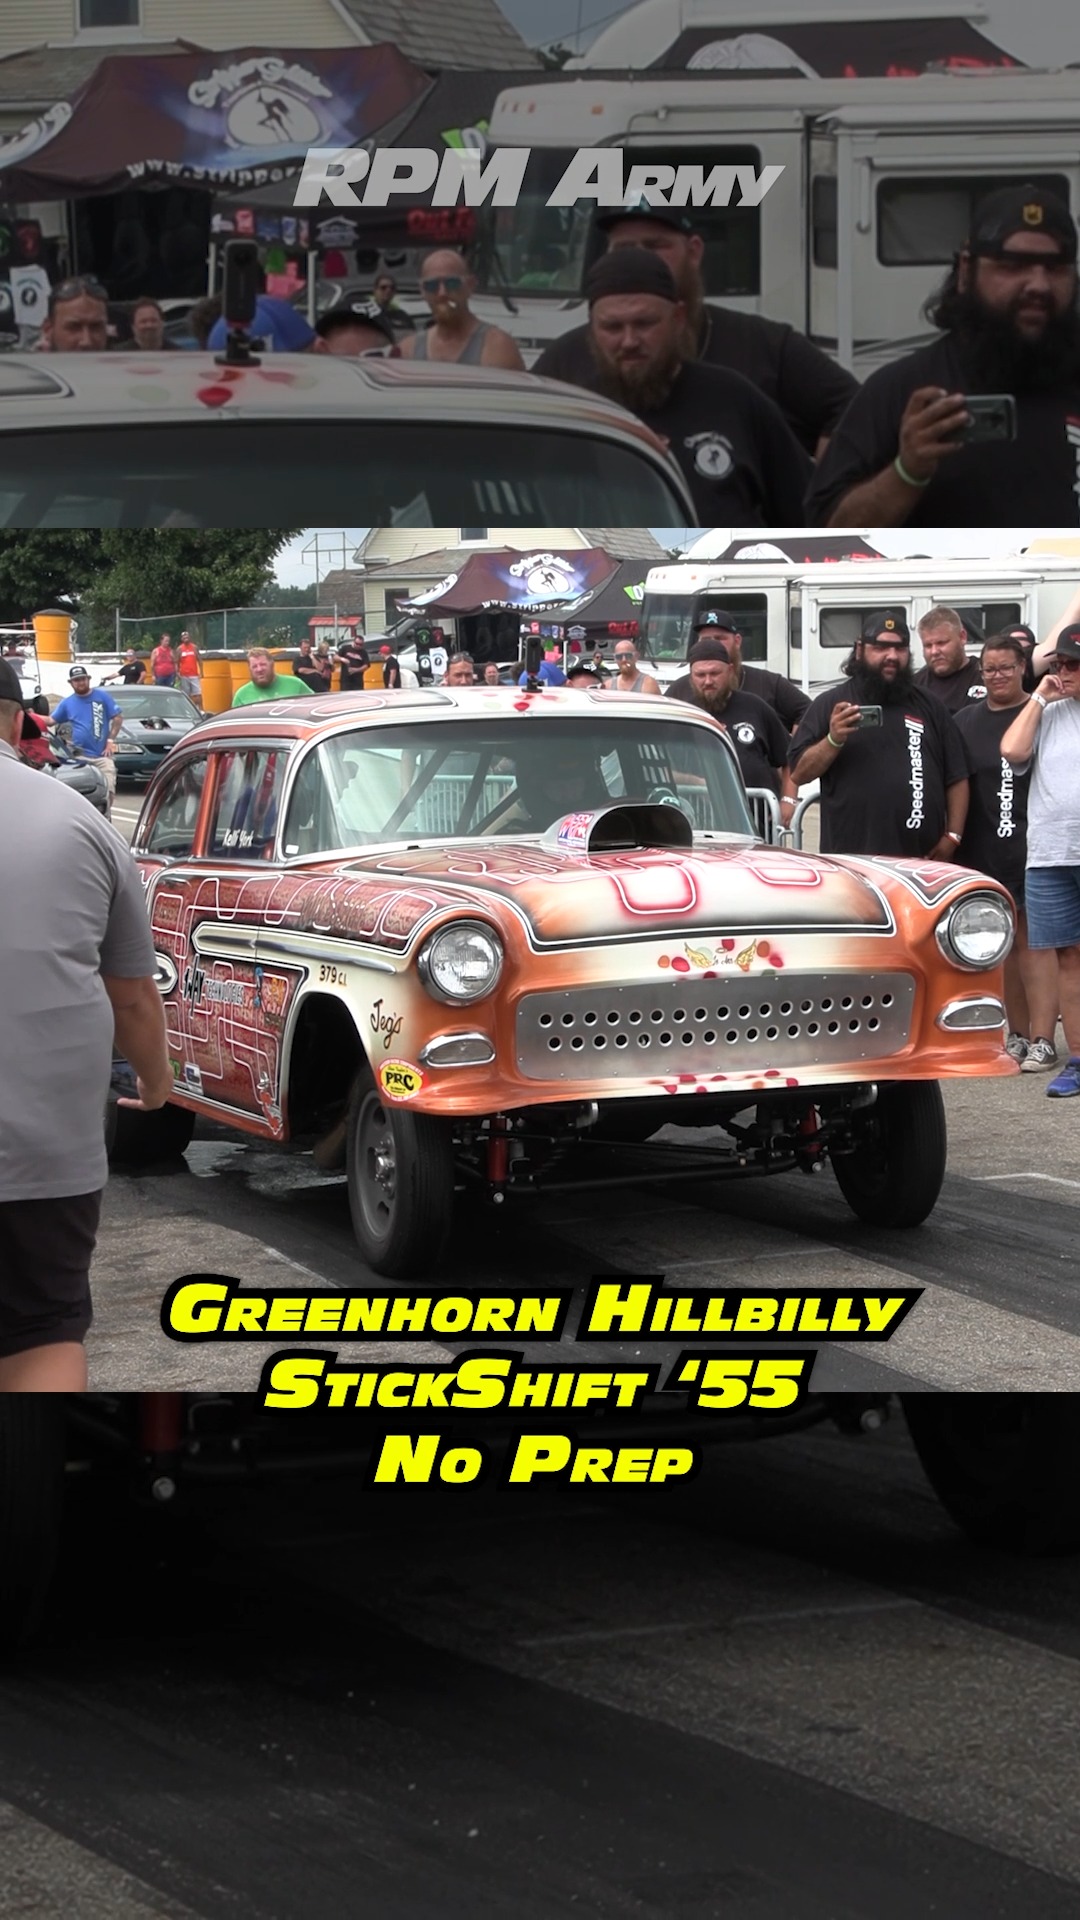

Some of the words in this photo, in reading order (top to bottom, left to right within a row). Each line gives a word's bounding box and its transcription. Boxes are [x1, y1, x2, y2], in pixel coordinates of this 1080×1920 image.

[126, 158, 305, 188] www.stripper
[481, 599, 567, 613] www.stripper
[905, 729, 925, 829] Speedmaster
[997, 756, 1016, 838] Speedmas
[319, 964, 338, 984] 379
[370, 998, 404, 1051] Jeg's
[385, 1071, 415, 1092] PRC
